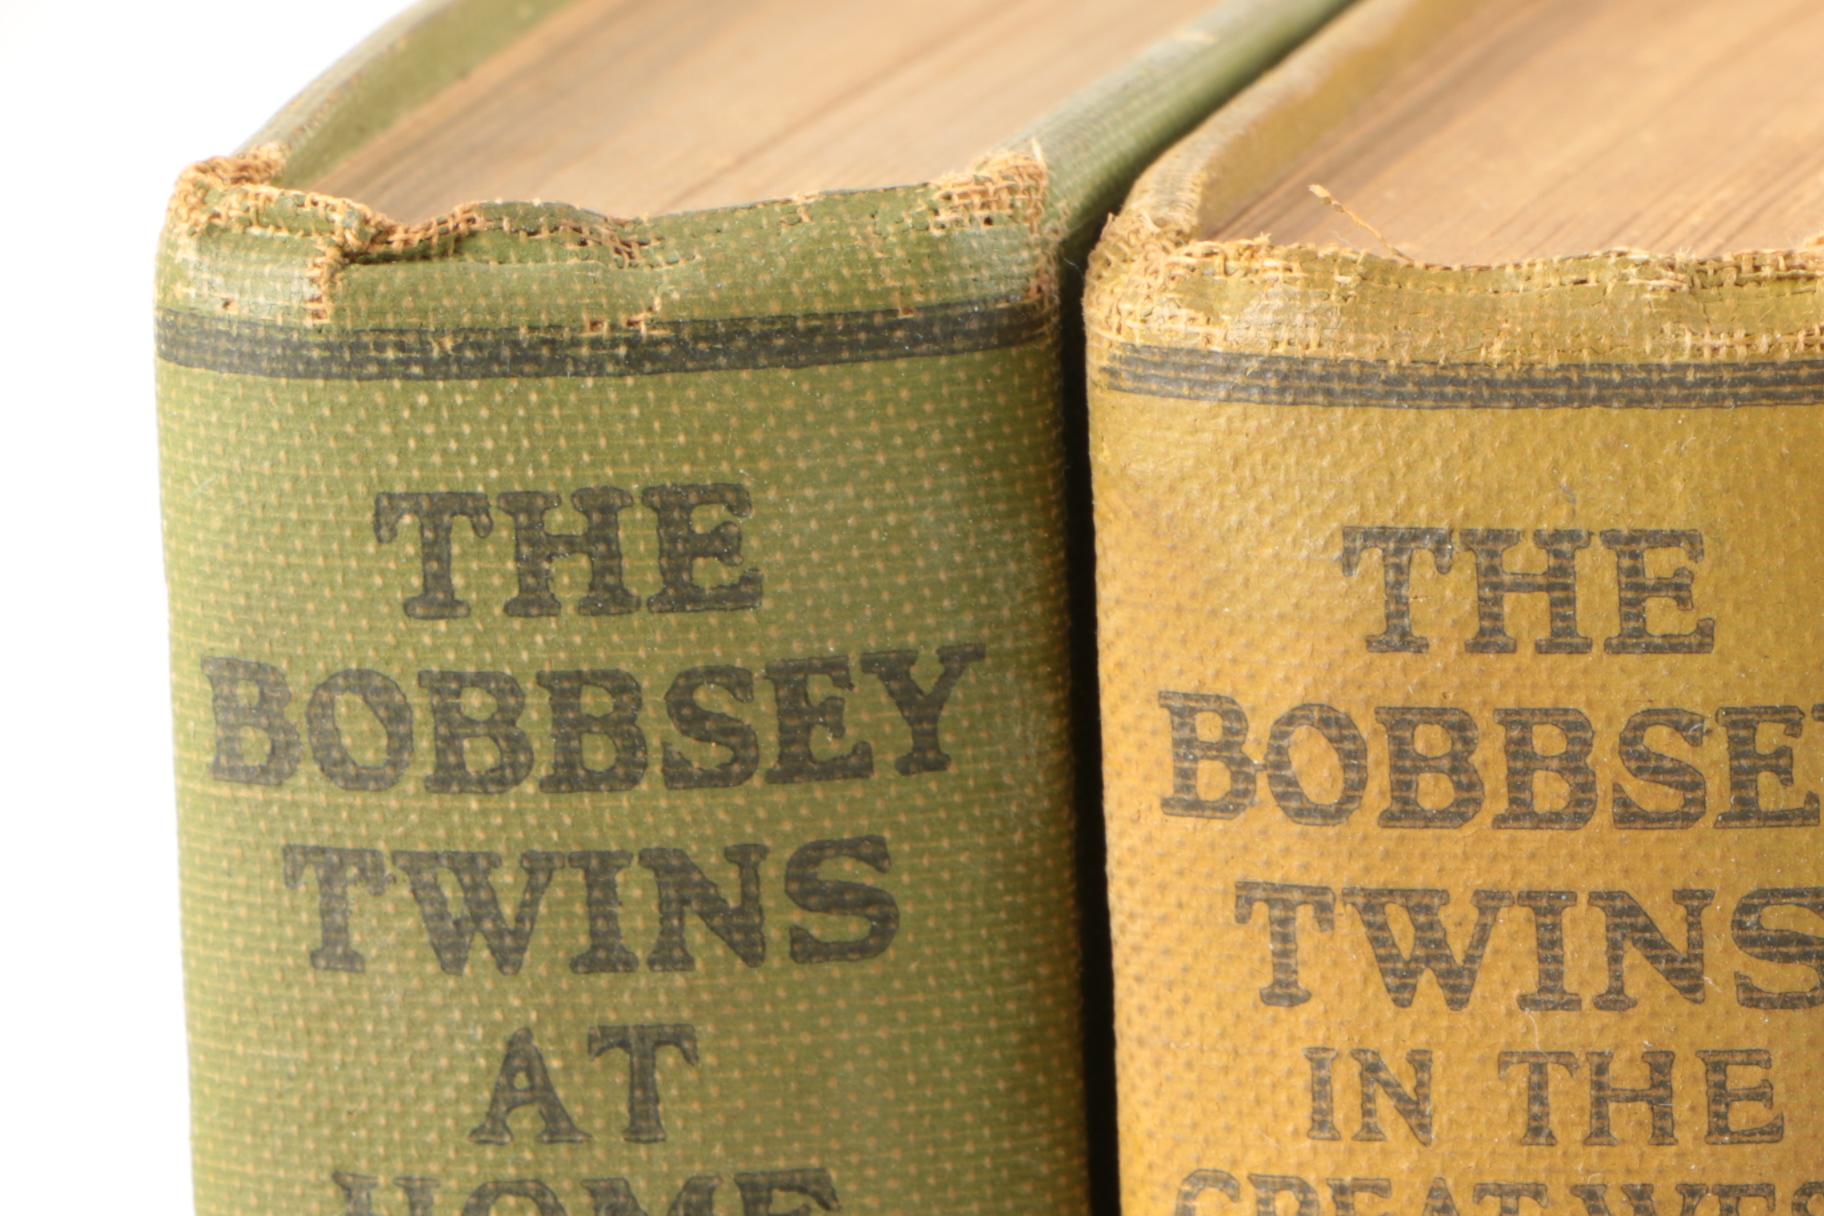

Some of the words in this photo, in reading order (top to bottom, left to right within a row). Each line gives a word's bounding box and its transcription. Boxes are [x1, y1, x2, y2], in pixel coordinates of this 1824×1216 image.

[373, 483, 764, 620] THE
[1341, 525, 1715, 656] THE
[200, 643, 987, 794] BOBBSEY
[282, 835, 901, 976] TWINS
[469, 1023, 700, 1144] AT
[1304, 1046, 1434, 1146] IN
[1498, 1047, 1785, 1147] THE
